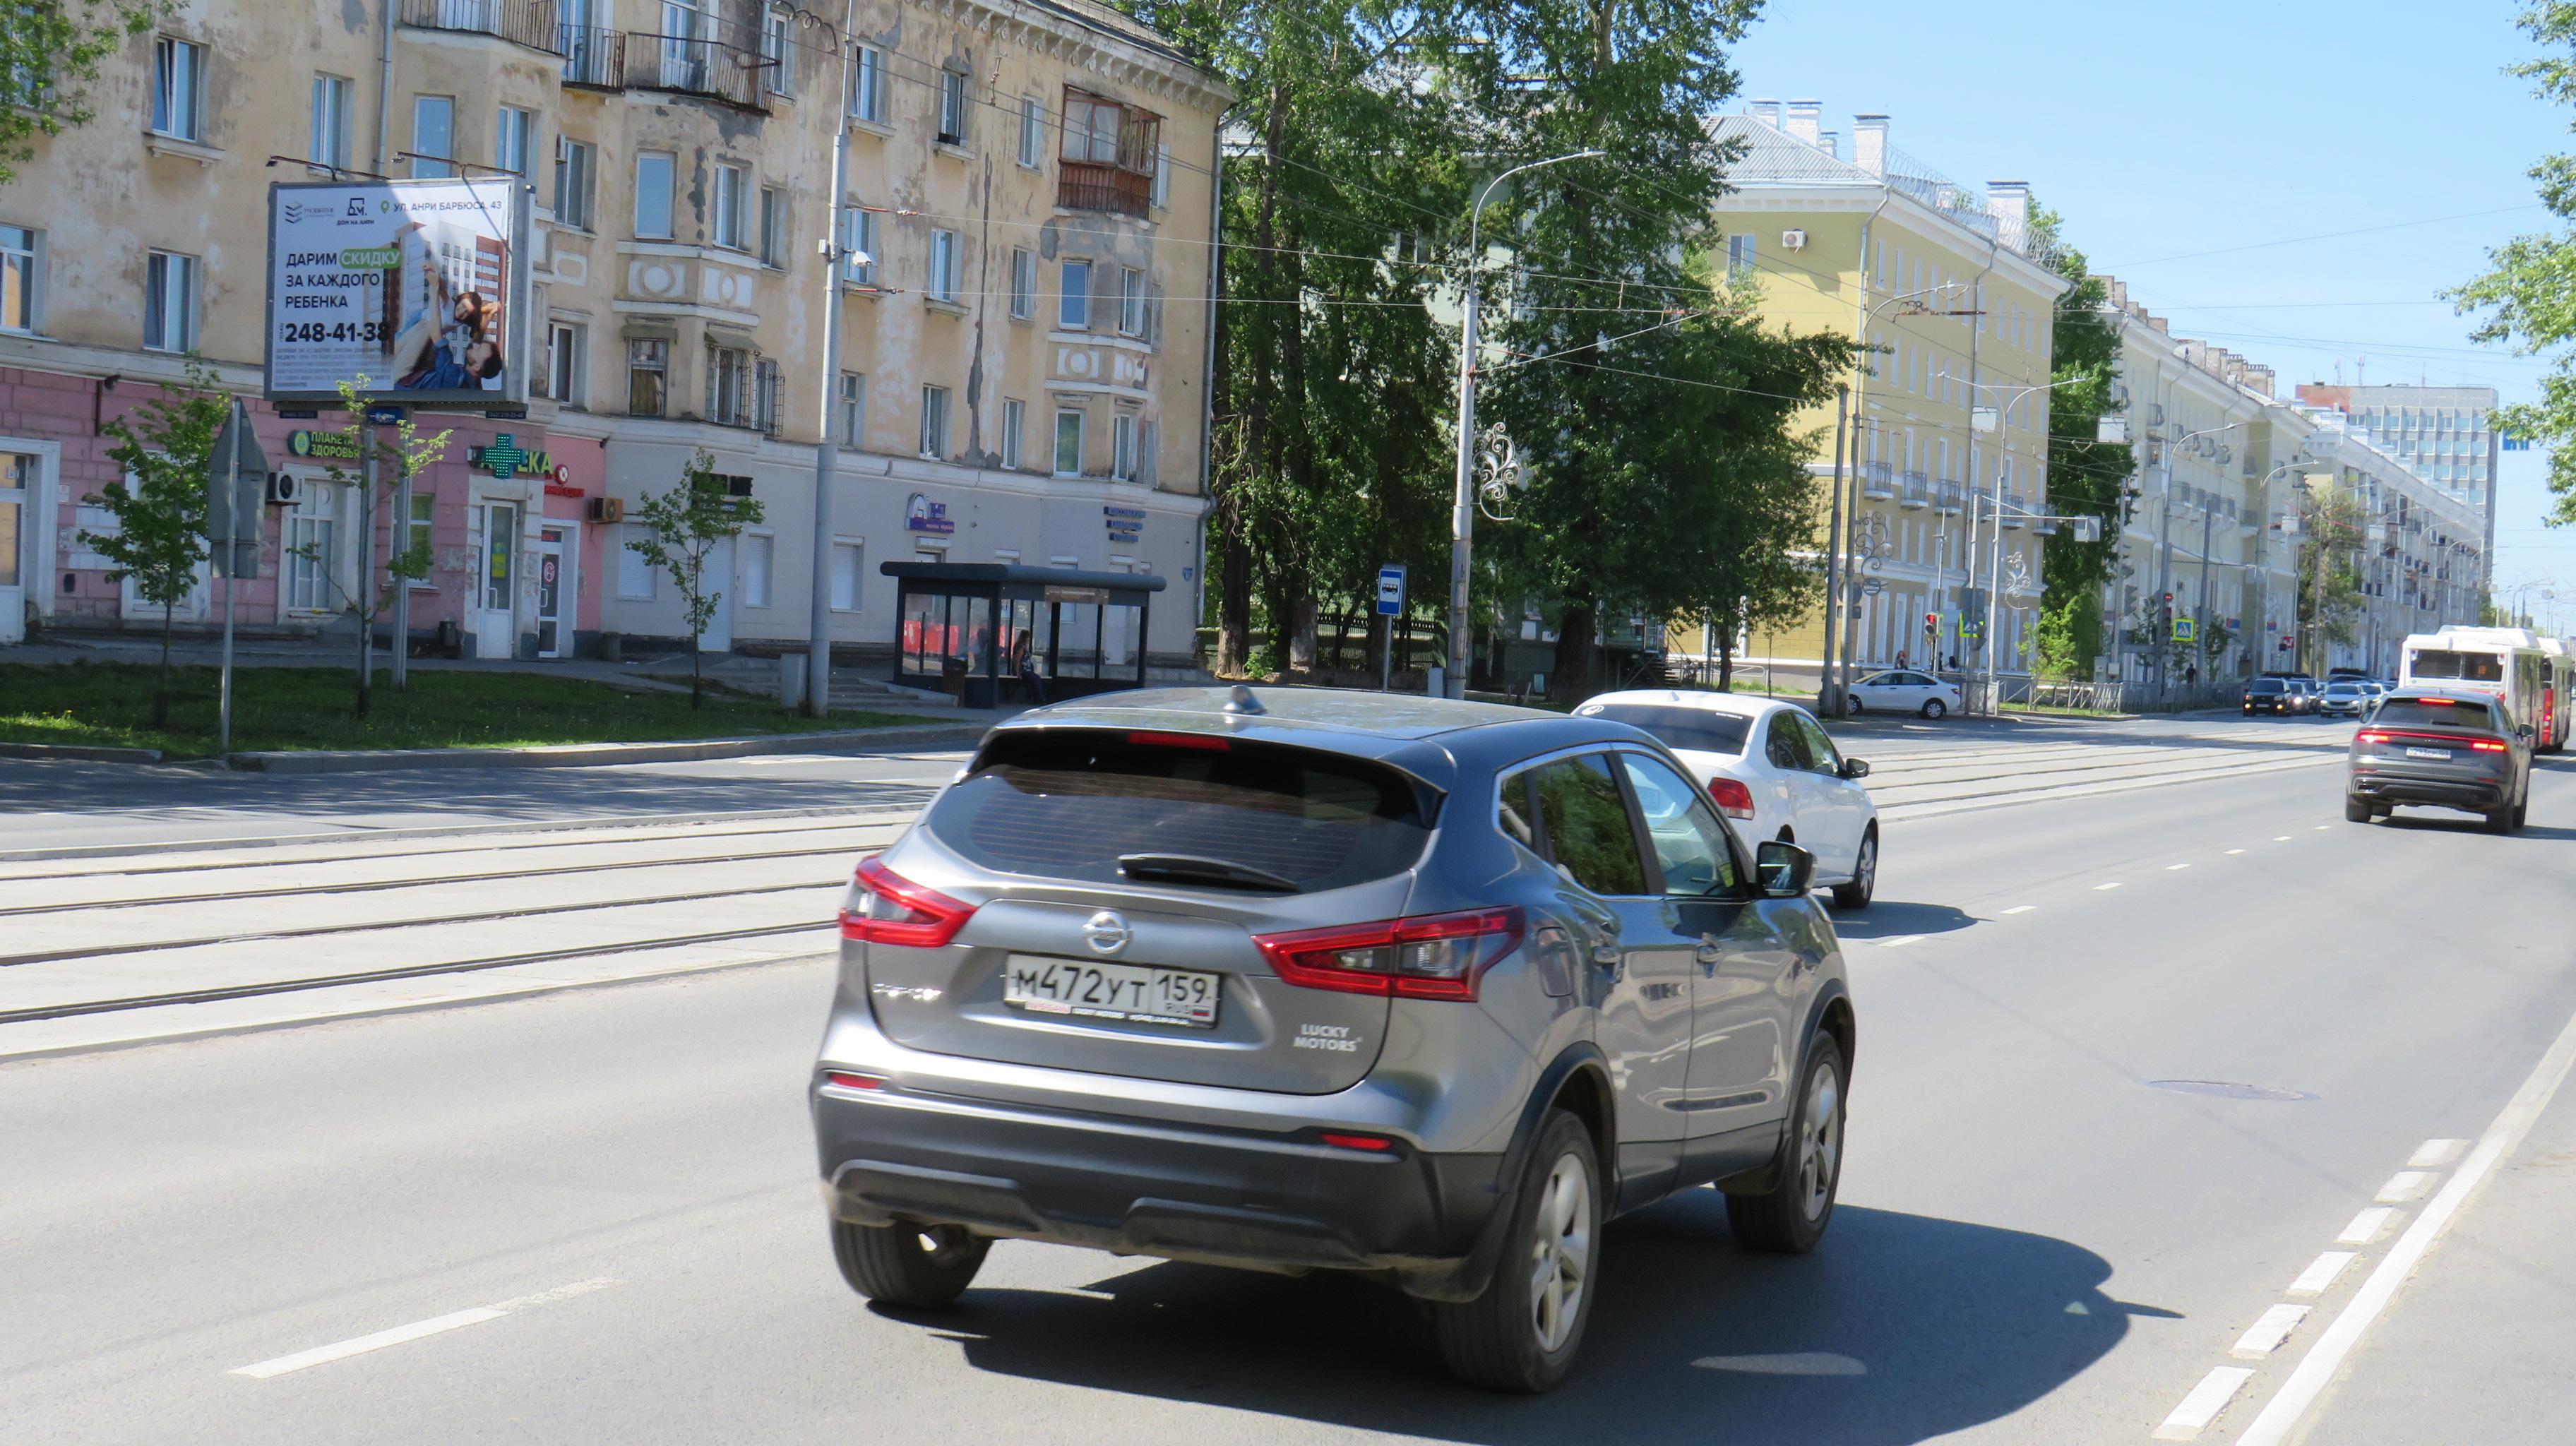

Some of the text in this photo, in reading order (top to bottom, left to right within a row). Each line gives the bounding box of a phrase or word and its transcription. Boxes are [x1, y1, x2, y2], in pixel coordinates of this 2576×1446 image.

[412, 202, 437, 211] АНРИ
[491, 201, 502, 210] 43
[286, 251, 400, 268] ДАРИМ СКИДКУ
[286, 273, 381, 288] ЗА КАЖДОГО
[285, 295, 349, 309] РЕБЕНКА
[285, 322, 390, 342] 248-41-38
[311, 444, 360, 459] ЗДОРОВЬЯ
[1157, 974, 1208, 1003] 159
[1301, 1024, 1350, 1038] LUCKY
[1293, 1036, 1357, 1052] MOTORS
